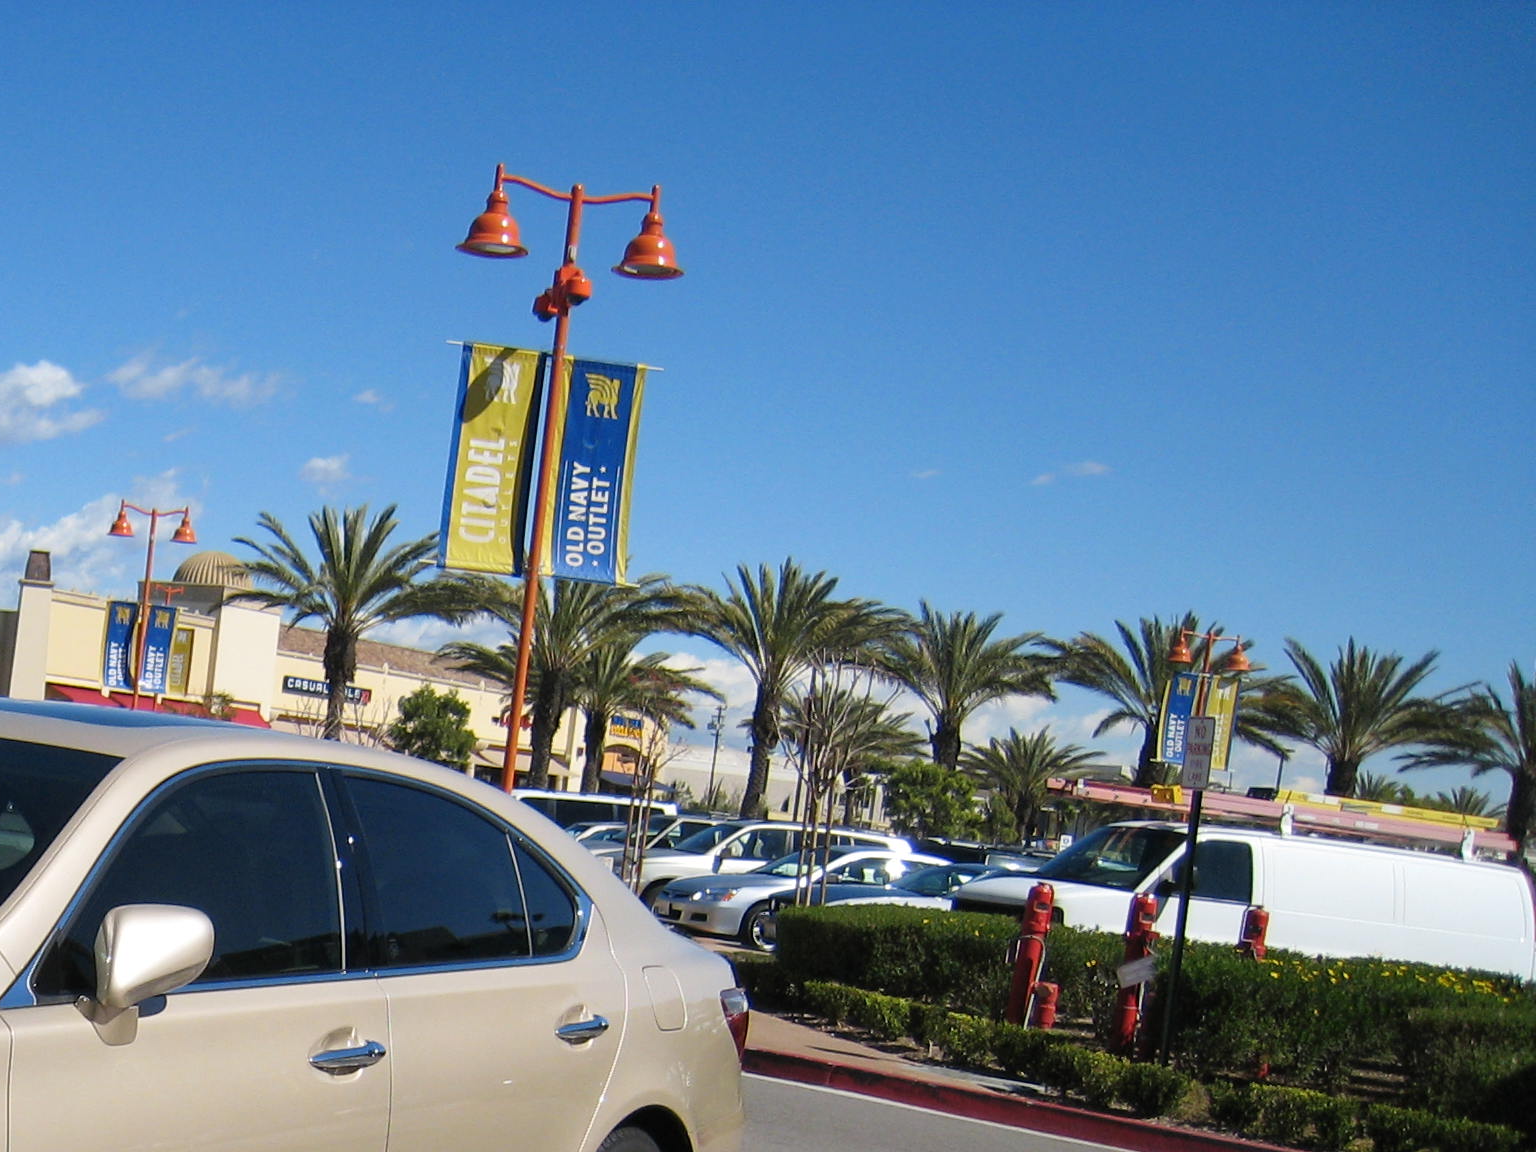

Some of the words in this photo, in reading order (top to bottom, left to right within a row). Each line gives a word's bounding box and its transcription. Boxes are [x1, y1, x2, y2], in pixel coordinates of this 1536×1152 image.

[459, 438, 505, 544] CITADEL
[568, 461, 591, 521] NAVY
[586, 477, 611, 555] OUTLET
[565, 526, 585, 568] OLD
[109, 641, 119, 667] NAVY
[146, 645, 156, 670] NAVY
[153, 651, 164, 686] OUTLET
[108, 669, 117, 686] OLD
[287, 678, 329, 694] CASUAL
[1168, 713, 1178, 738] NAVY
[1175, 720, 1185, 753] OUTLET
[1166, 740, 1175, 758] OLD
